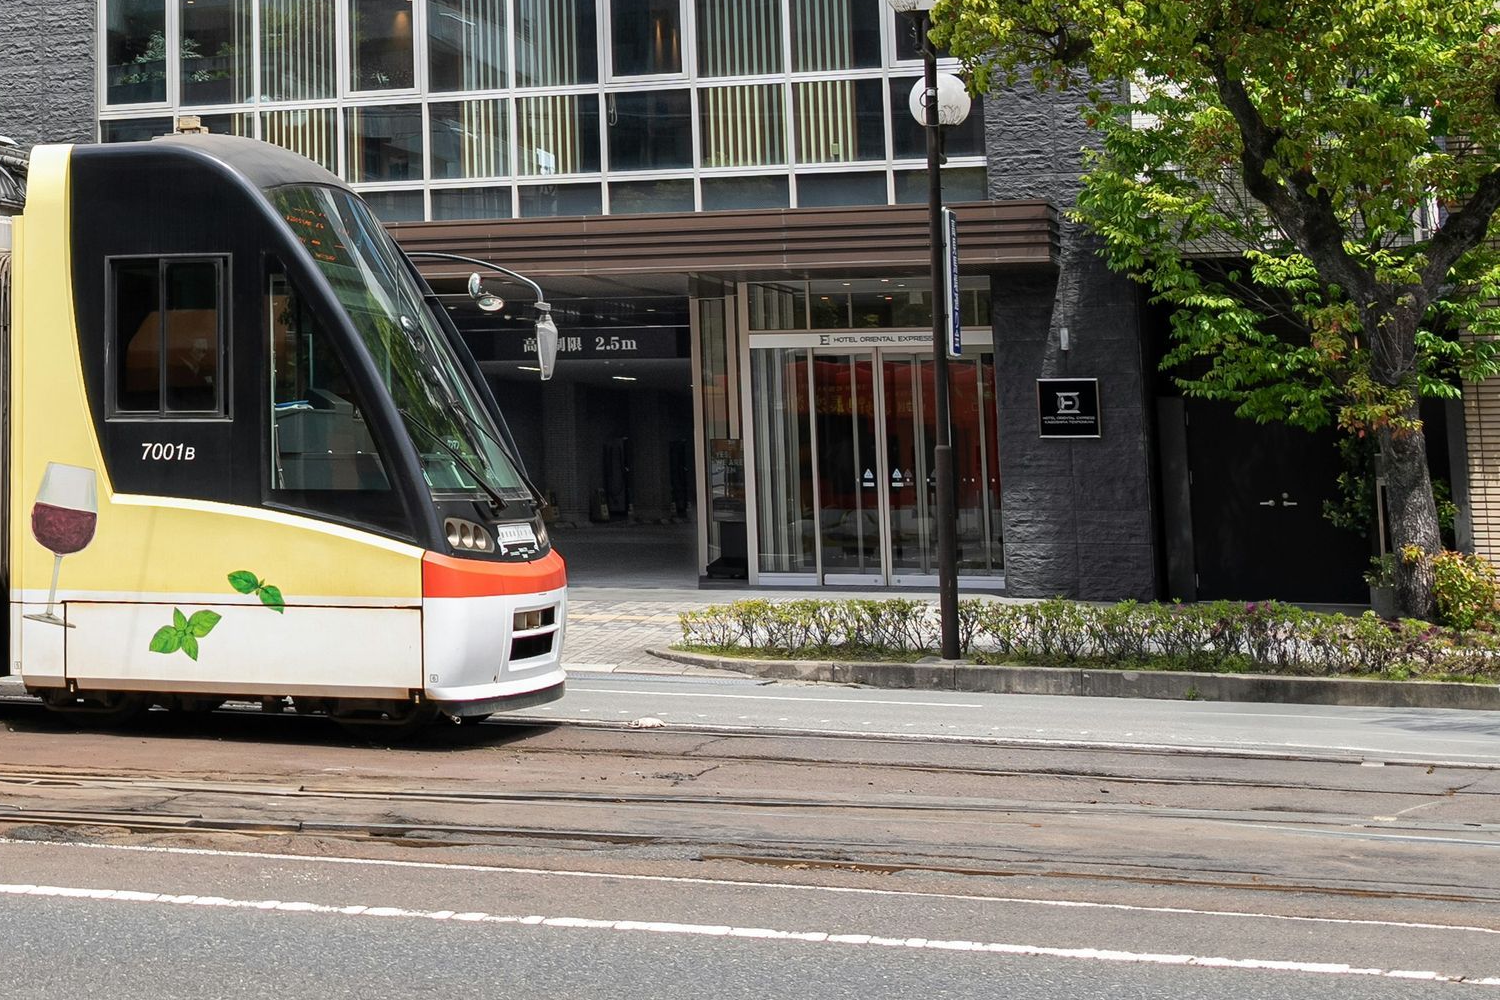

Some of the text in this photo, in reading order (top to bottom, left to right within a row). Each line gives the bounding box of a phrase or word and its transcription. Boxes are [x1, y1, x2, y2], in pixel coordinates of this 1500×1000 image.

[595, 336, 638, 350] 2.5m
[860, 335, 896, 343] ORIENTAL
[141, 443, 196, 461] 7001B
